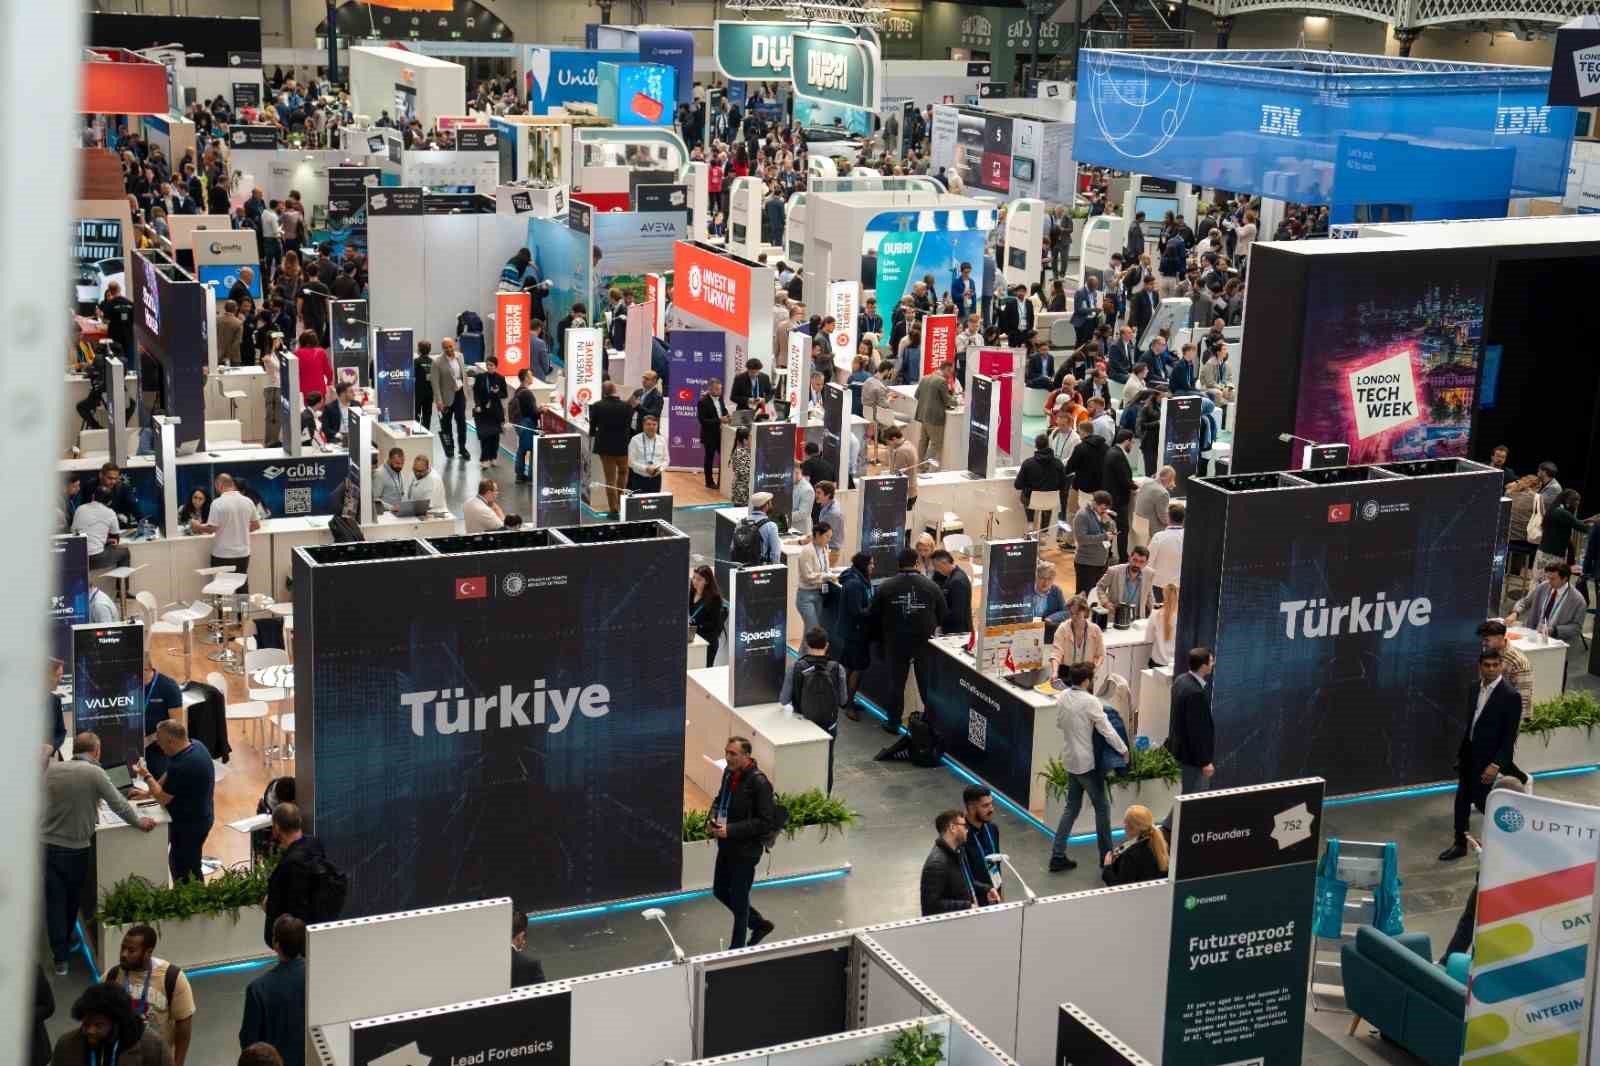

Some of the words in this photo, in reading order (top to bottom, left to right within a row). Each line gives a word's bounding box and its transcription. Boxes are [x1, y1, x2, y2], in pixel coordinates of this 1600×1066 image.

[1008, 21, 1024, 38] EAT
[1260, 105, 1302, 137] IBM
[1495, 106, 1551, 135] IBM
[640, 222, 676, 232] AVEVA
[703, 268, 728, 289] INVEST
[728, 278, 736, 295] IN
[576, 341, 585, 352] IN
[576, 354, 585, 385] INVEST
[1357, 374, 1400, 385] LONDON
[1357, 387, 1399, 403] TECH
[1367, 401, 1413, 418] WEEK
[1280, 592, 1432, 640] Türkiye
[85, 696, 134, 709] VALVEN
[401, 679, 610, 737] Türkiye
[1206, 829, 1251, 842] Founders
[1283, 819, 1302, 832] 752
[1189, 921, 1295, 952] Futureproof
[1189, 951, 1229, 971] your
[1236, 939, 1293, 961] career
[451, 1050, 485, 1066] Lead
[487, 1039, 553, 1061] Forensics
